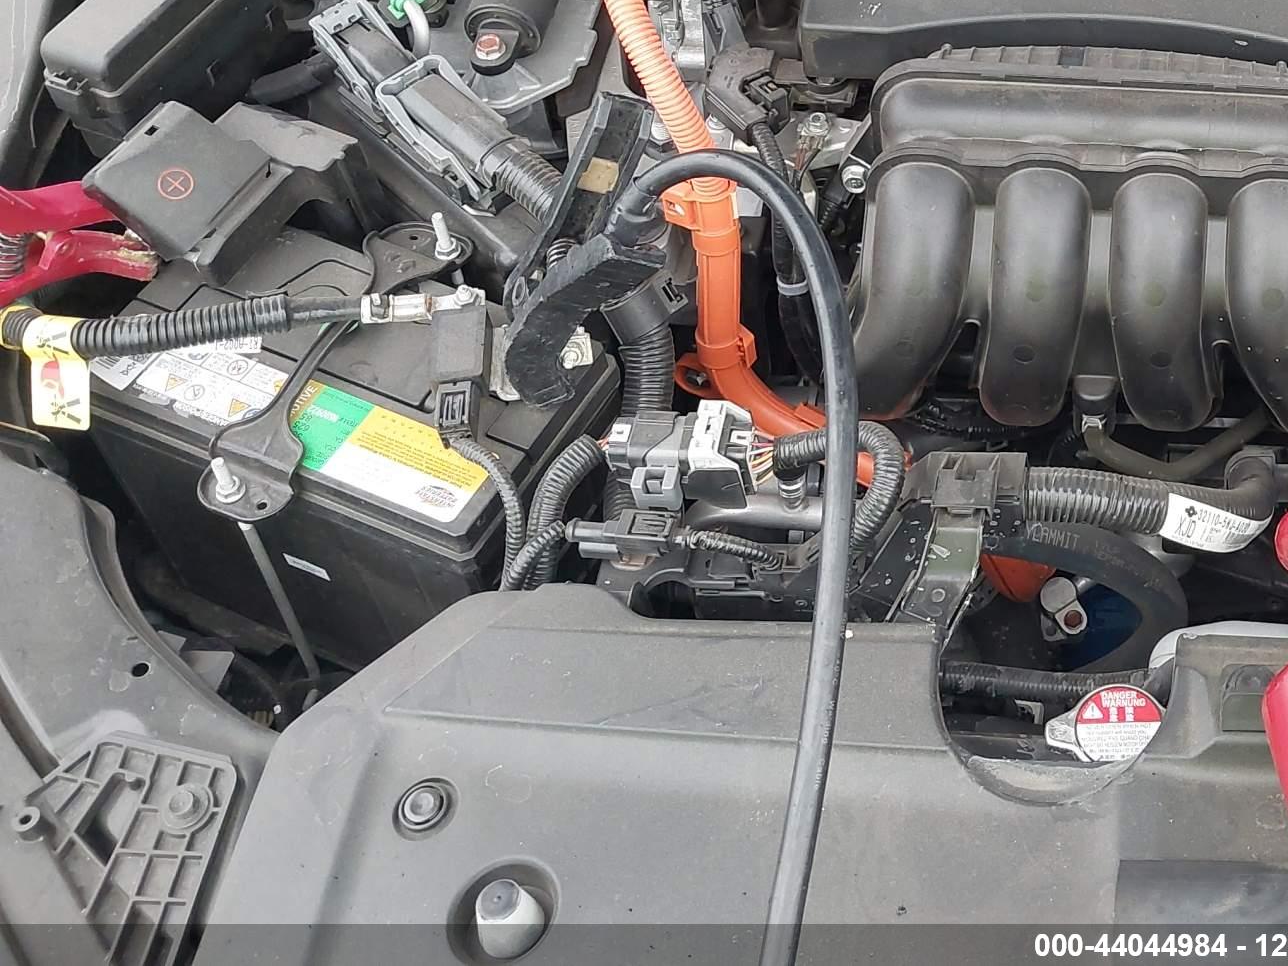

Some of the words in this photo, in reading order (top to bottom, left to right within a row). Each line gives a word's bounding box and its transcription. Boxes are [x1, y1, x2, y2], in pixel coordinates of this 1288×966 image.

[1174, 515, 1196, 538] XJD
[1100, 691, 1137, 699] DANGER
[1102, 698, 1146, 707] WARNUNG
